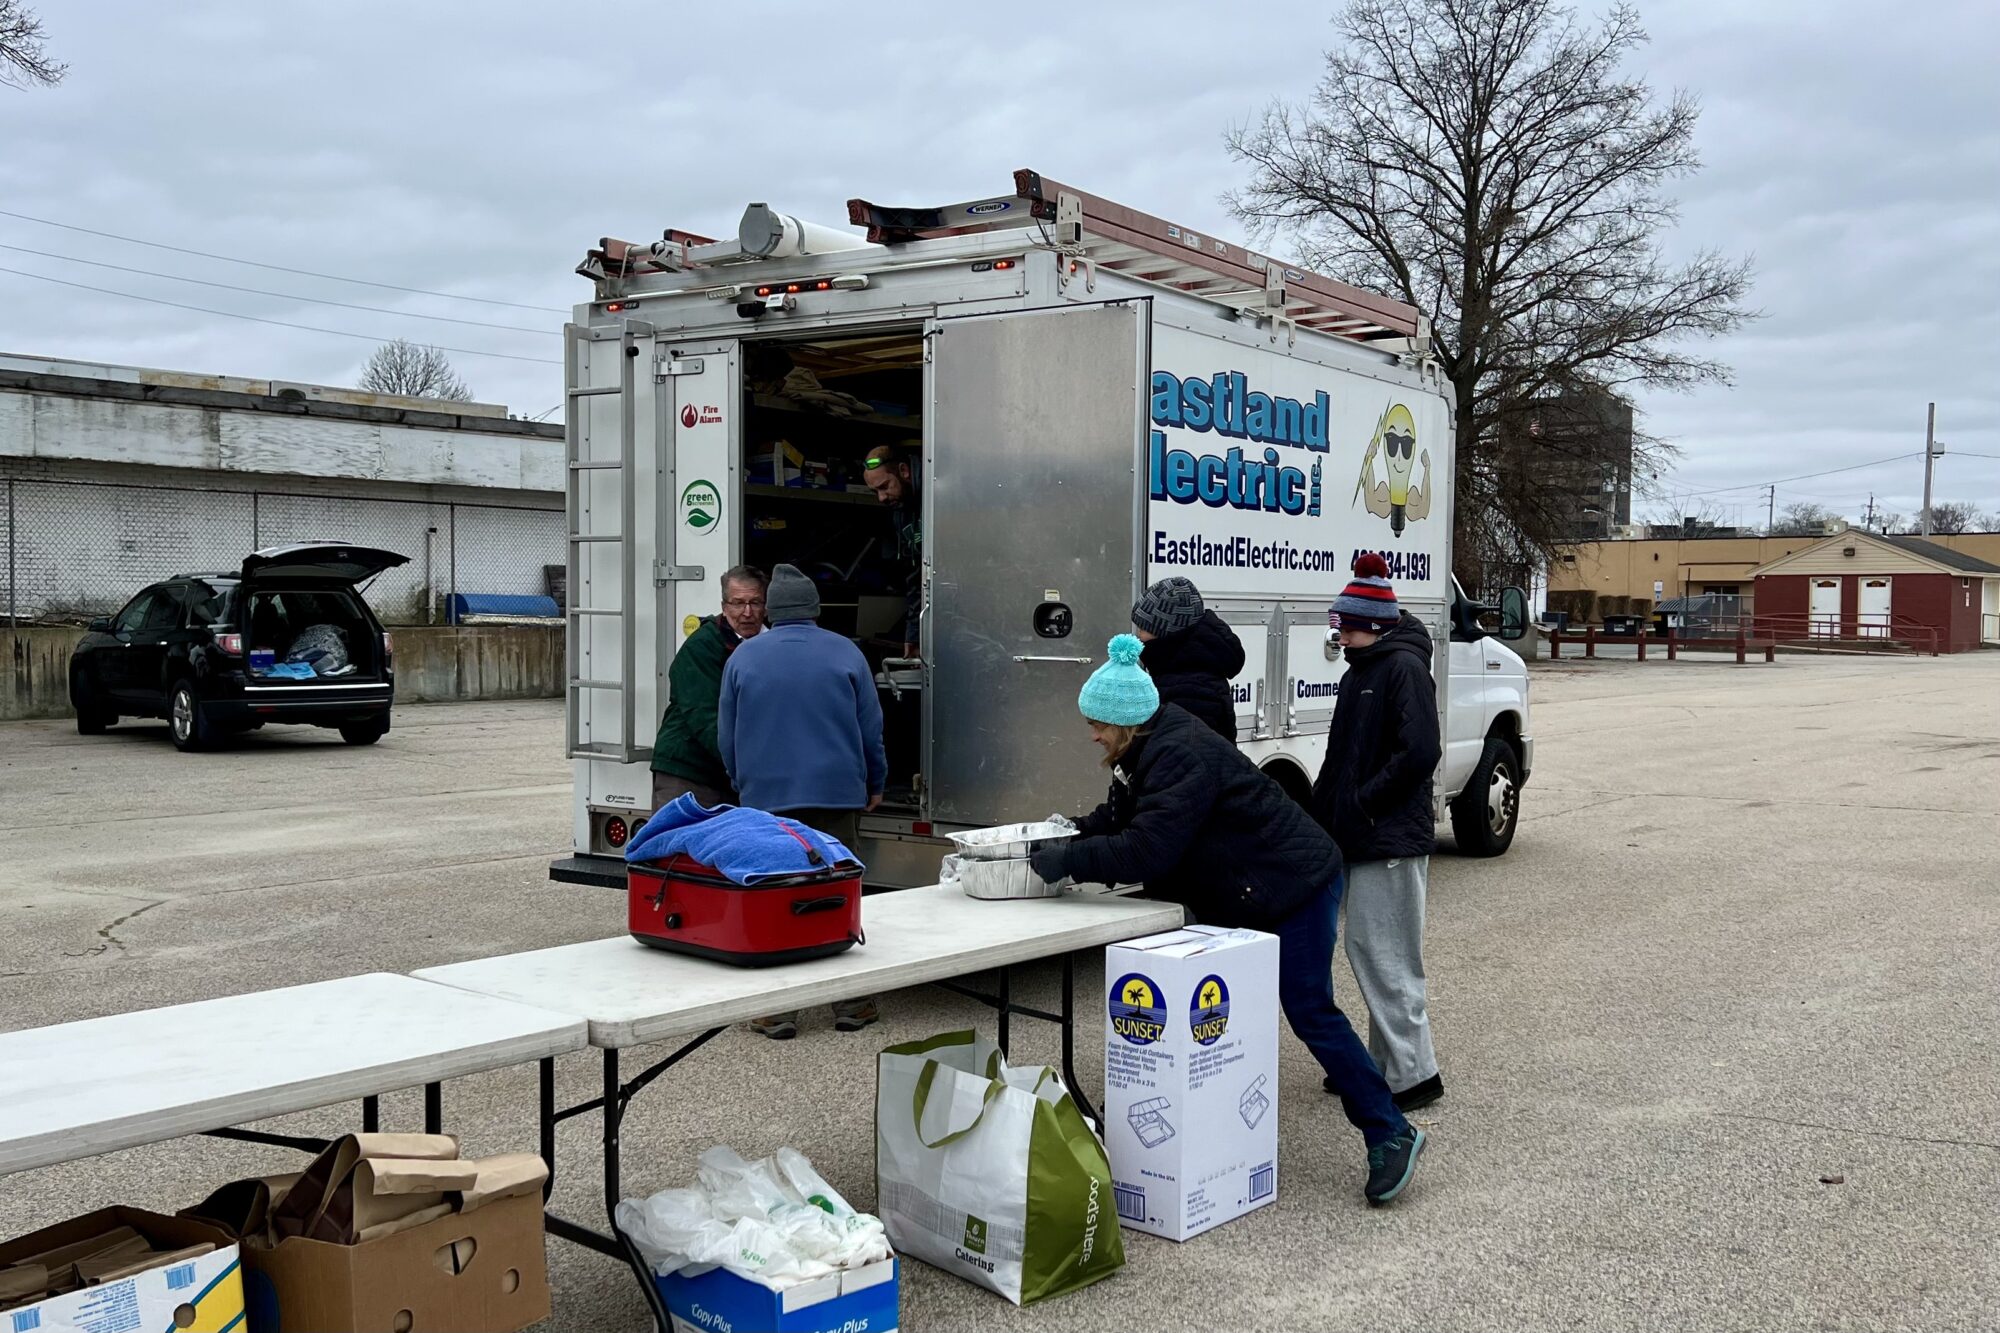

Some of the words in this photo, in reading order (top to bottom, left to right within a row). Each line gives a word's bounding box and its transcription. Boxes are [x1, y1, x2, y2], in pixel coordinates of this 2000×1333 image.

[976, 204, 1001, 212] WERNER
[703, 405, 718, 414] Fire
[1152, 370, 1330, 453] astland
[699, 416, 722, 424] Alarm
[1151, 429, 1306, 516] lectric
[686, 493, 713, 506] green
[1149, 531, 1334, 572] .EastlandElectric.com
[1297, 680, 1339, 698] Comme
[1114, 1017, 1163, 1041] SUNSET
[1193, 1018, 1227, 1041] SUNSET
[1108, 1041, 1121, 1050] Foam
[1122, 1044, 1139, 1054] Hinged
[1147, 1049, 1174, 1060] Containers
[1121, 1052, 1140, 1061] Optional
[1108, 1057, 1121, 1065] White
[1122, 1060, 1141, 1069] Medium
[1142, 1064, 1156, 1072] Three
[1108, 1064, 1139, 1076] Compartment
[1086, 1176, 1099, 1225] ood's
[955, 1247, 994, 1273] Catering
[691, 1303, 713, 1327] Copy
[713, 1313, 732, 1333] Plus
[844, 1318, 868, 1333] Plus
